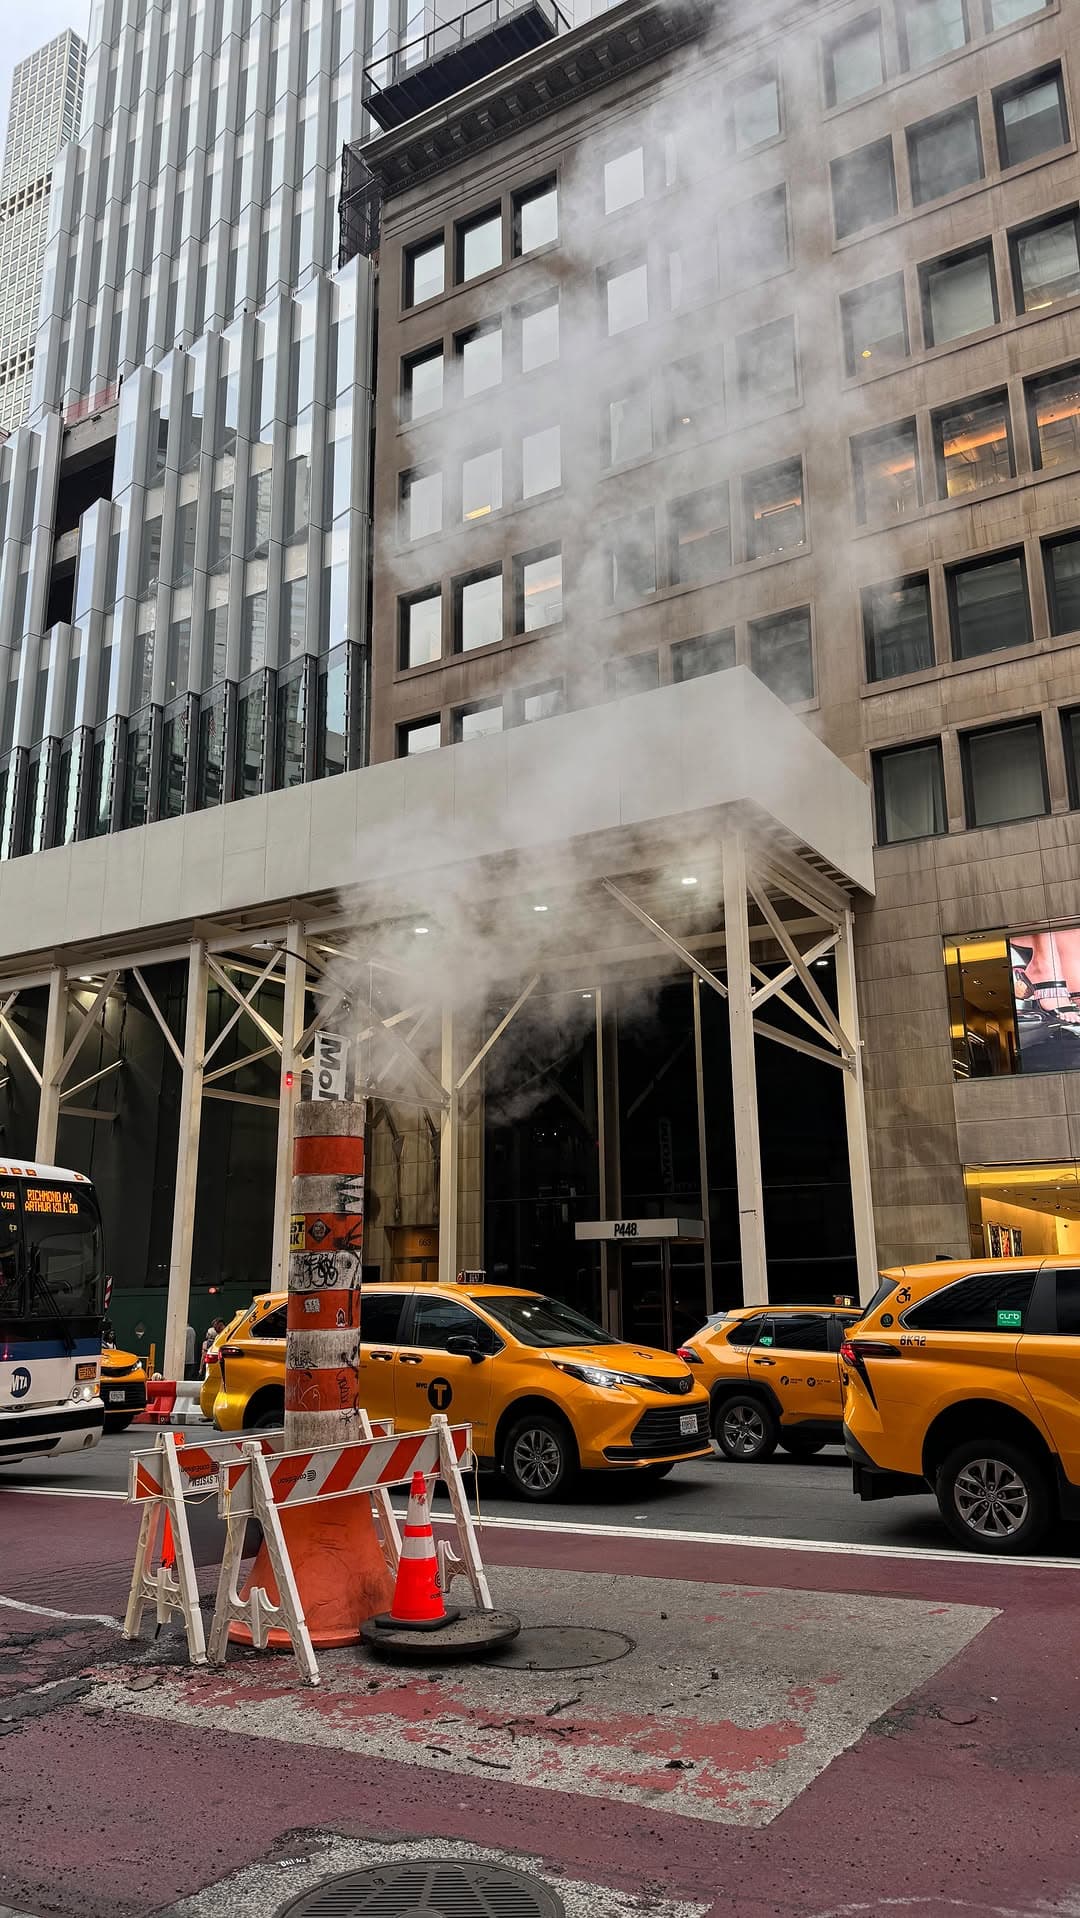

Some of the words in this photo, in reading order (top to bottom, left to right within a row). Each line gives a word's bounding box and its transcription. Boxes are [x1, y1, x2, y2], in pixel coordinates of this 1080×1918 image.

[1, 1191, 15, 1200] VIA
[27, 1189, 61, 1203] RICHMOND
[1, 1202, 15, 1210] VIA
[25, 1201, 52, 1212] ARTHUR
[53, 1203, 68, 1214] KILL
[69, 1204, 79, 1214] RD
[614, 1223, 637, 1237] P448
[999, 1312, 1020, 1320] curb
[10, 1374, 29, 1393] MTA
